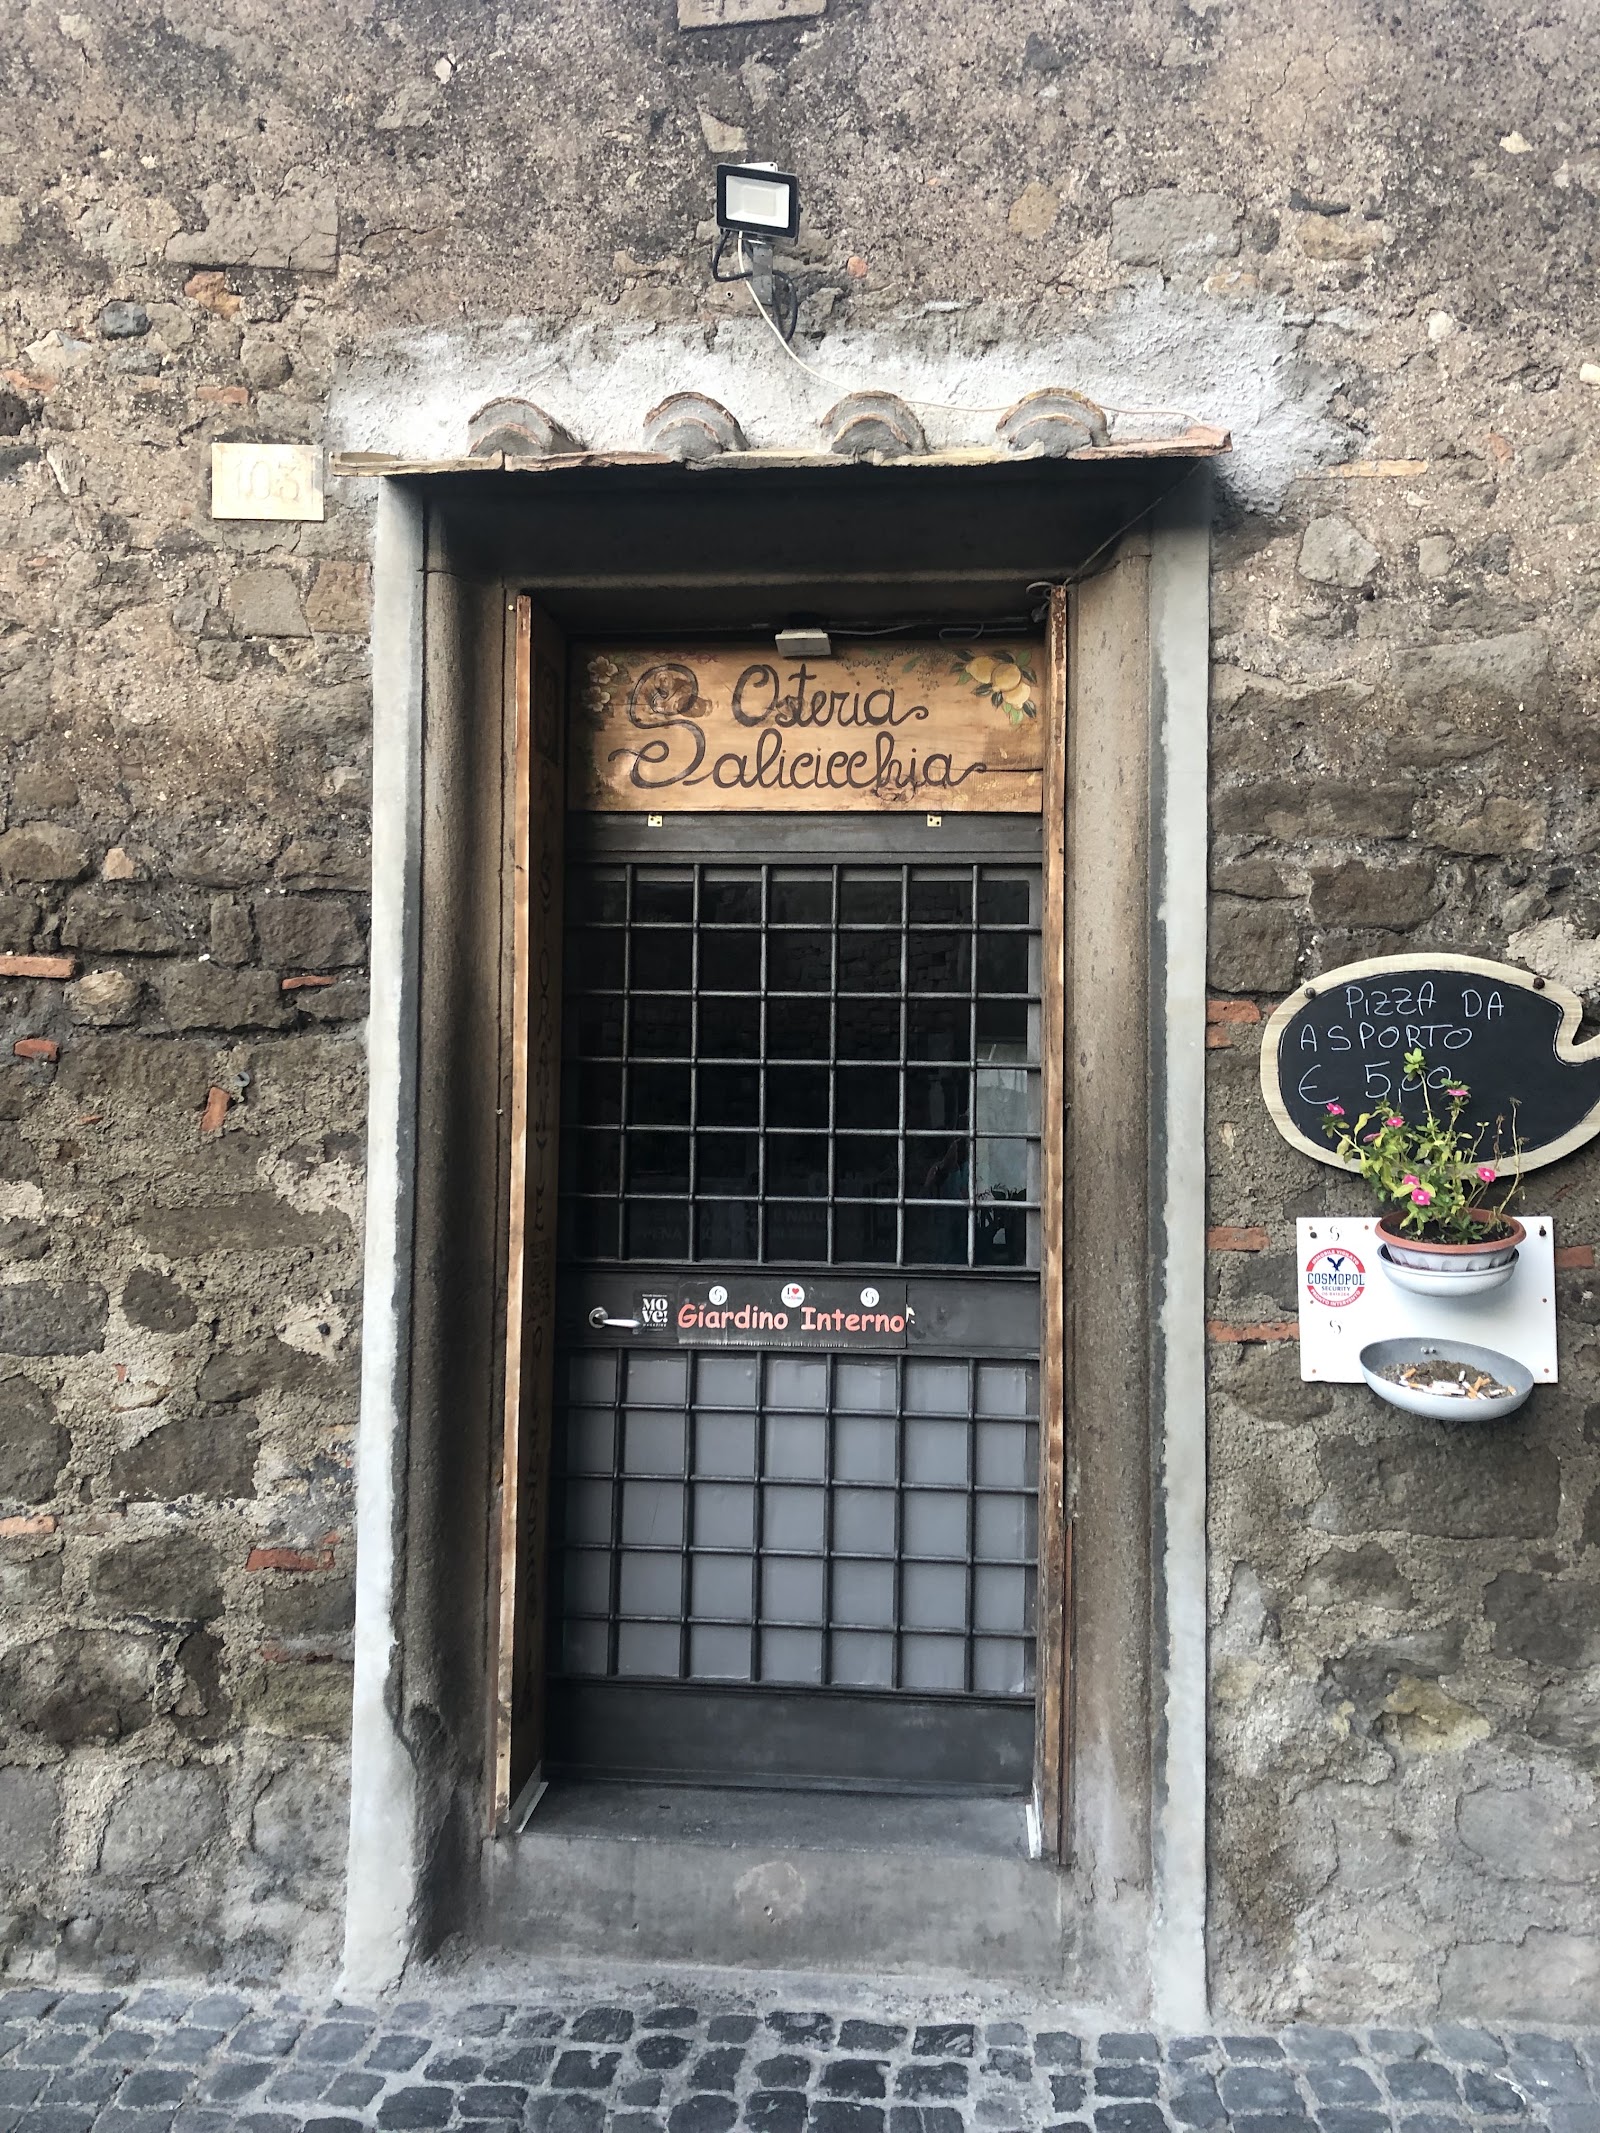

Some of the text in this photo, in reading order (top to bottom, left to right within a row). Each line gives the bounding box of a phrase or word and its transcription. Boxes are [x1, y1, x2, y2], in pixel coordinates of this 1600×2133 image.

[731, 662, 929, 727] Osteria
[607, 662, 987, 789] Salicicchia
[1346, 981, 1504, 1021] PIZZA DA
[1298, 1064, 1340, 1105] €
[1311, 1249, 1360, 1265] IMMOBILE VIGILATO
[1307, 1273, 1365, 1286] COSMOPOL
[1310, 1289, 1330, 1305] PRONTO
[677, 1303, 905, 1333] Giardino Interno
